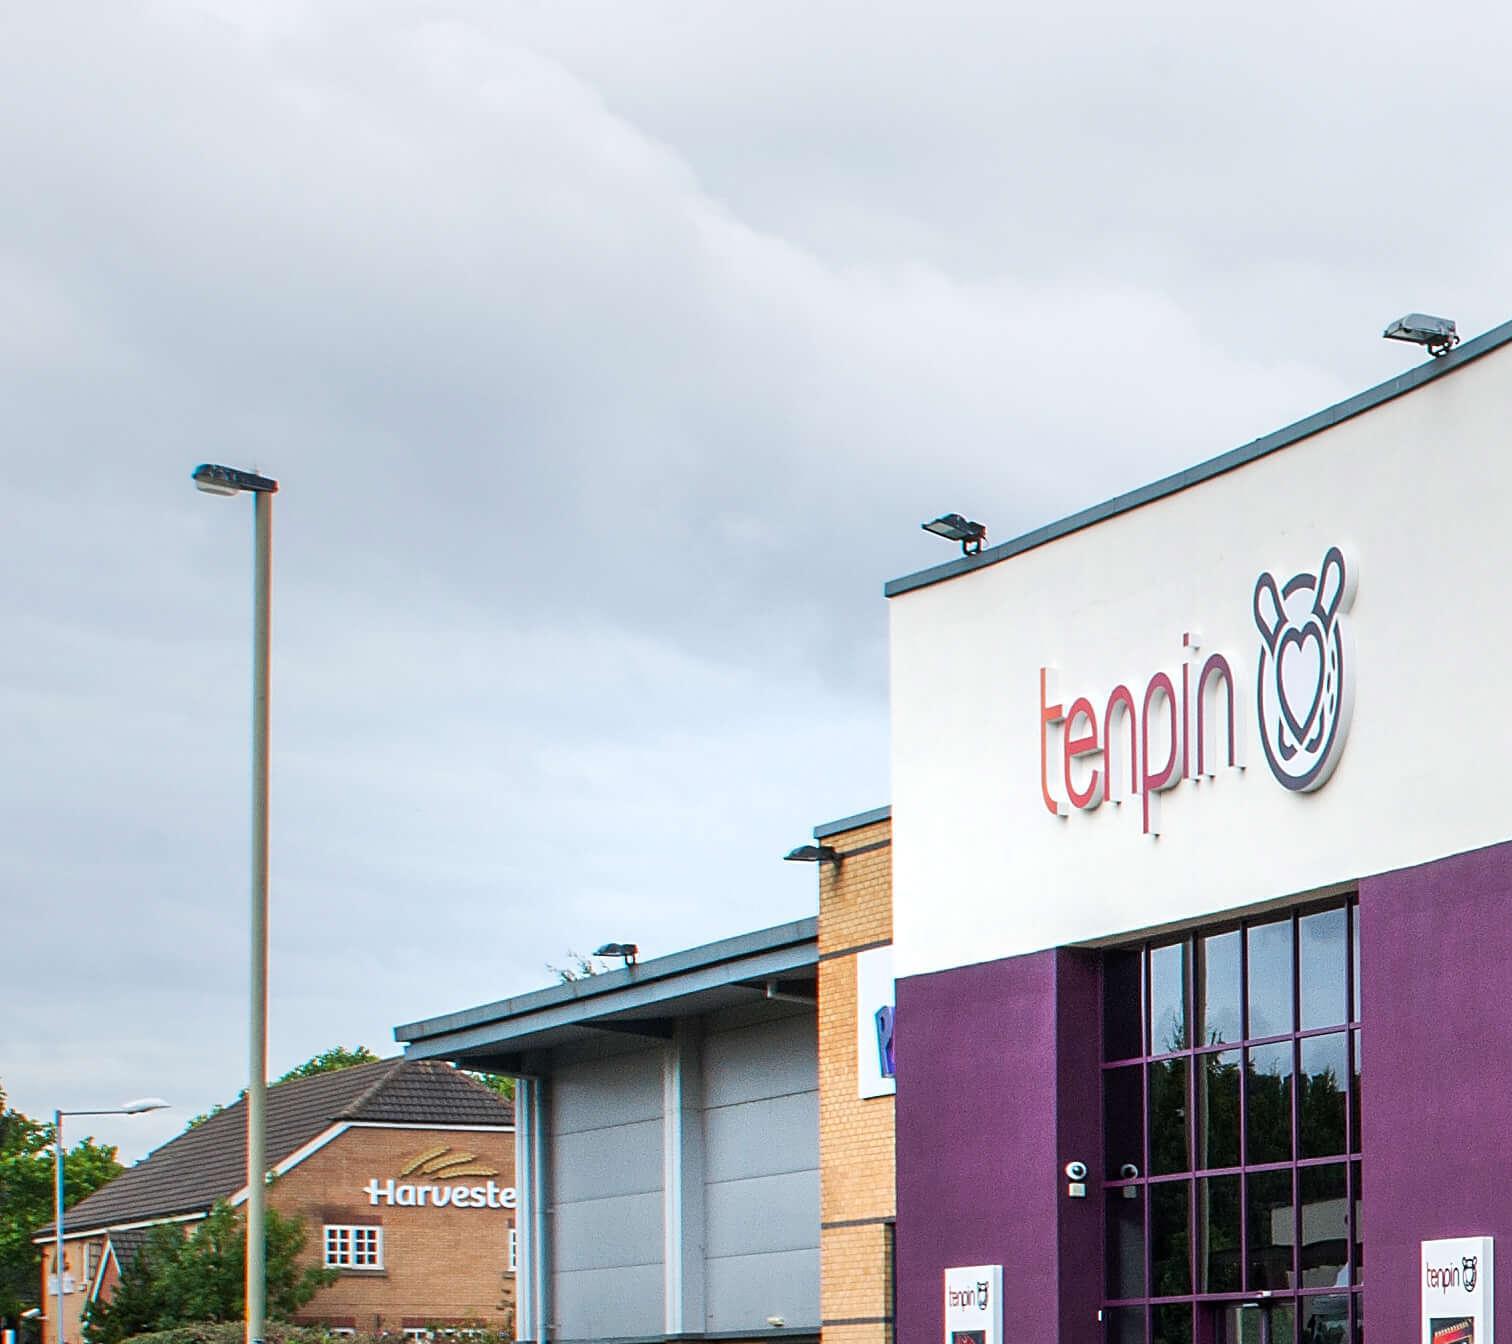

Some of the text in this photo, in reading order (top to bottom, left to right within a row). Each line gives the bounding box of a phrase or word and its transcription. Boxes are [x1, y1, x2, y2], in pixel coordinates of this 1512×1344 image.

[1040, 632, 1240, 835] tenpin
[1426, 1262, 1460, 1295] tenpin
[949, 1286, 975, 1311] tenpin
